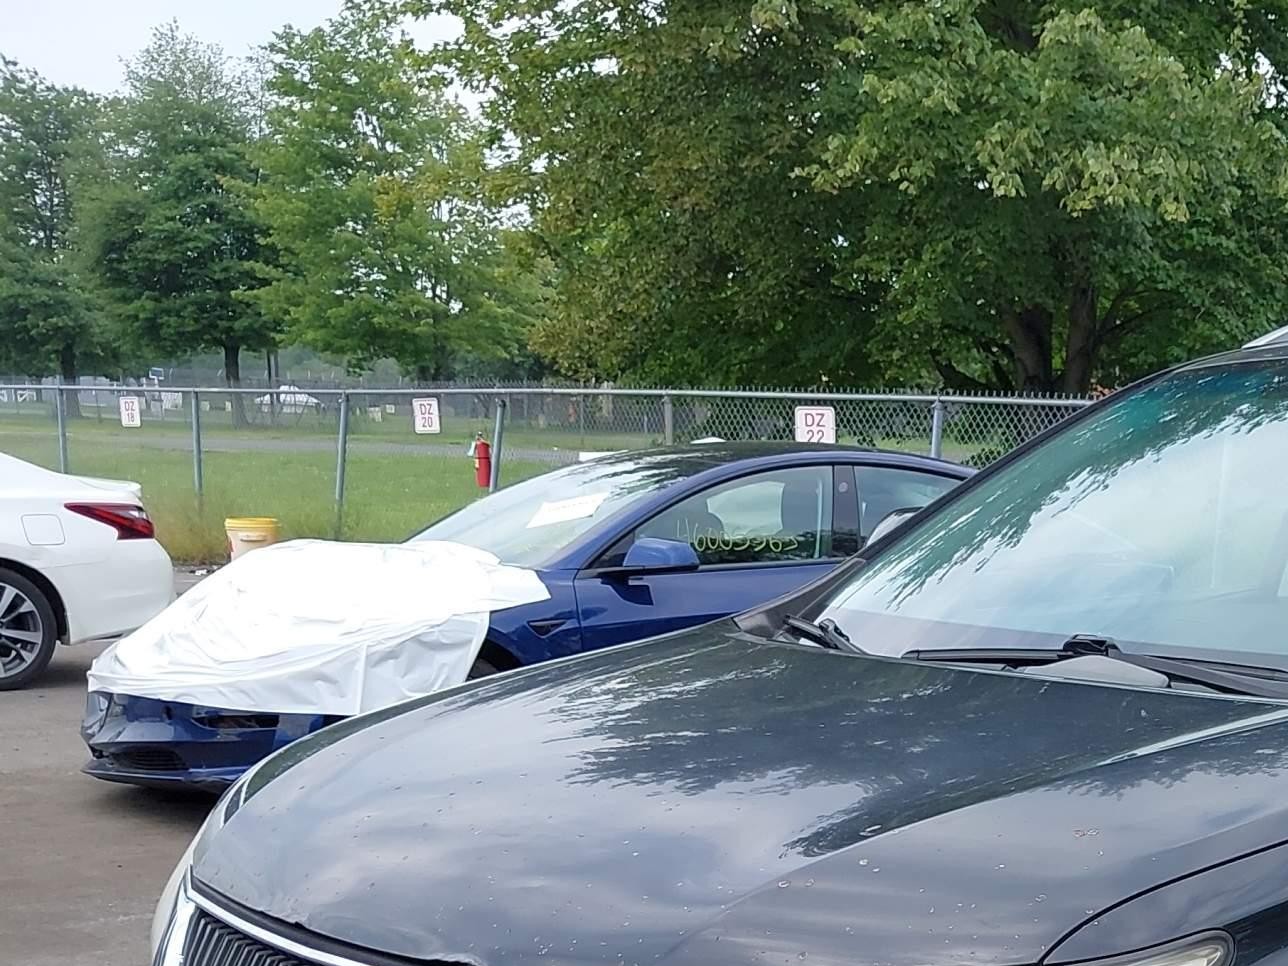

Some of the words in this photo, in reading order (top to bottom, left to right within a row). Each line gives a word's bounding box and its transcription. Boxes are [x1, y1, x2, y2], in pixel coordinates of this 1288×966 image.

[420, 403, 433, 415] DZ
[127, 412, 135, 422] 18
[422, 416, 433, 427] 20
[804, 413, 826, 427] DZ
[806, 429, 825, 443] 22
